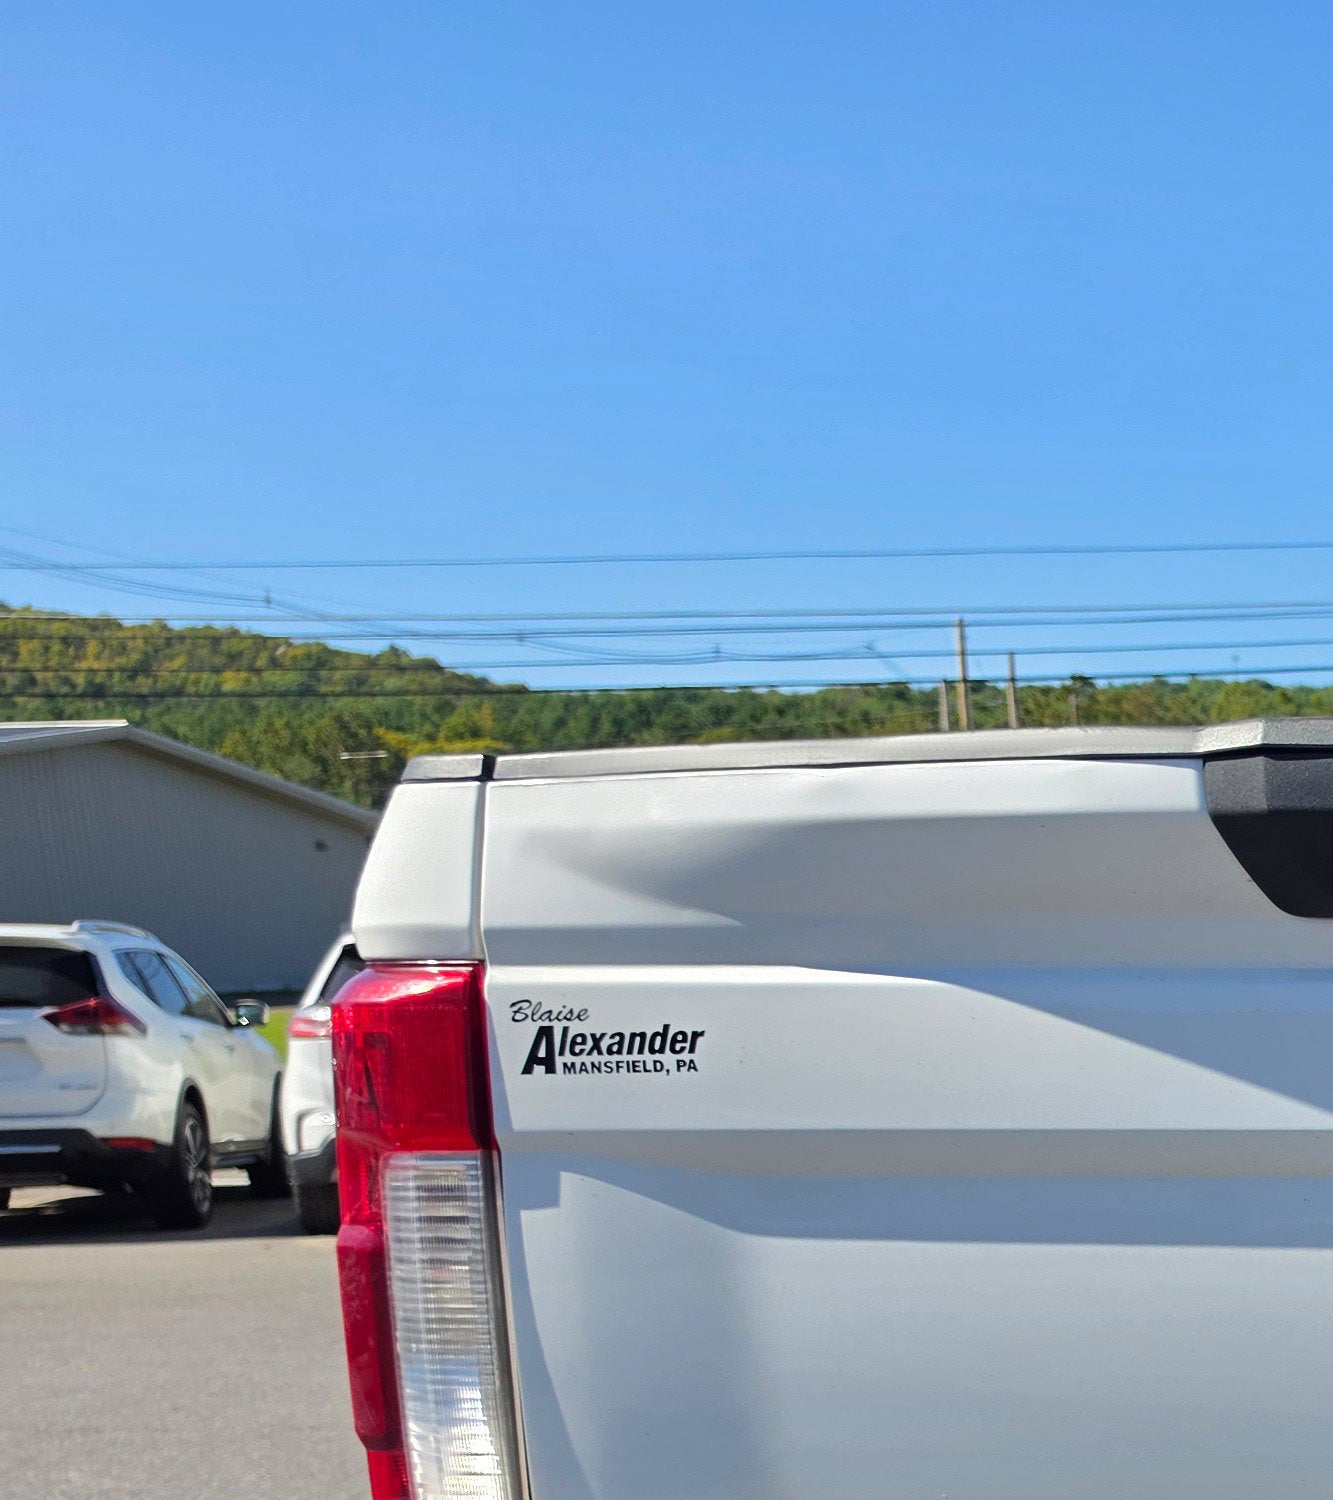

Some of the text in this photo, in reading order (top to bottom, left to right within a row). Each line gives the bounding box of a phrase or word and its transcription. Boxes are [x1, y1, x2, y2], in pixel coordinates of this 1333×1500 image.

[509, 999, 590, 1022] Blaise
[521, 1023, 705, 1075] Alexander
[562, 1059, 699, 1076] MANSFIELD, PA
